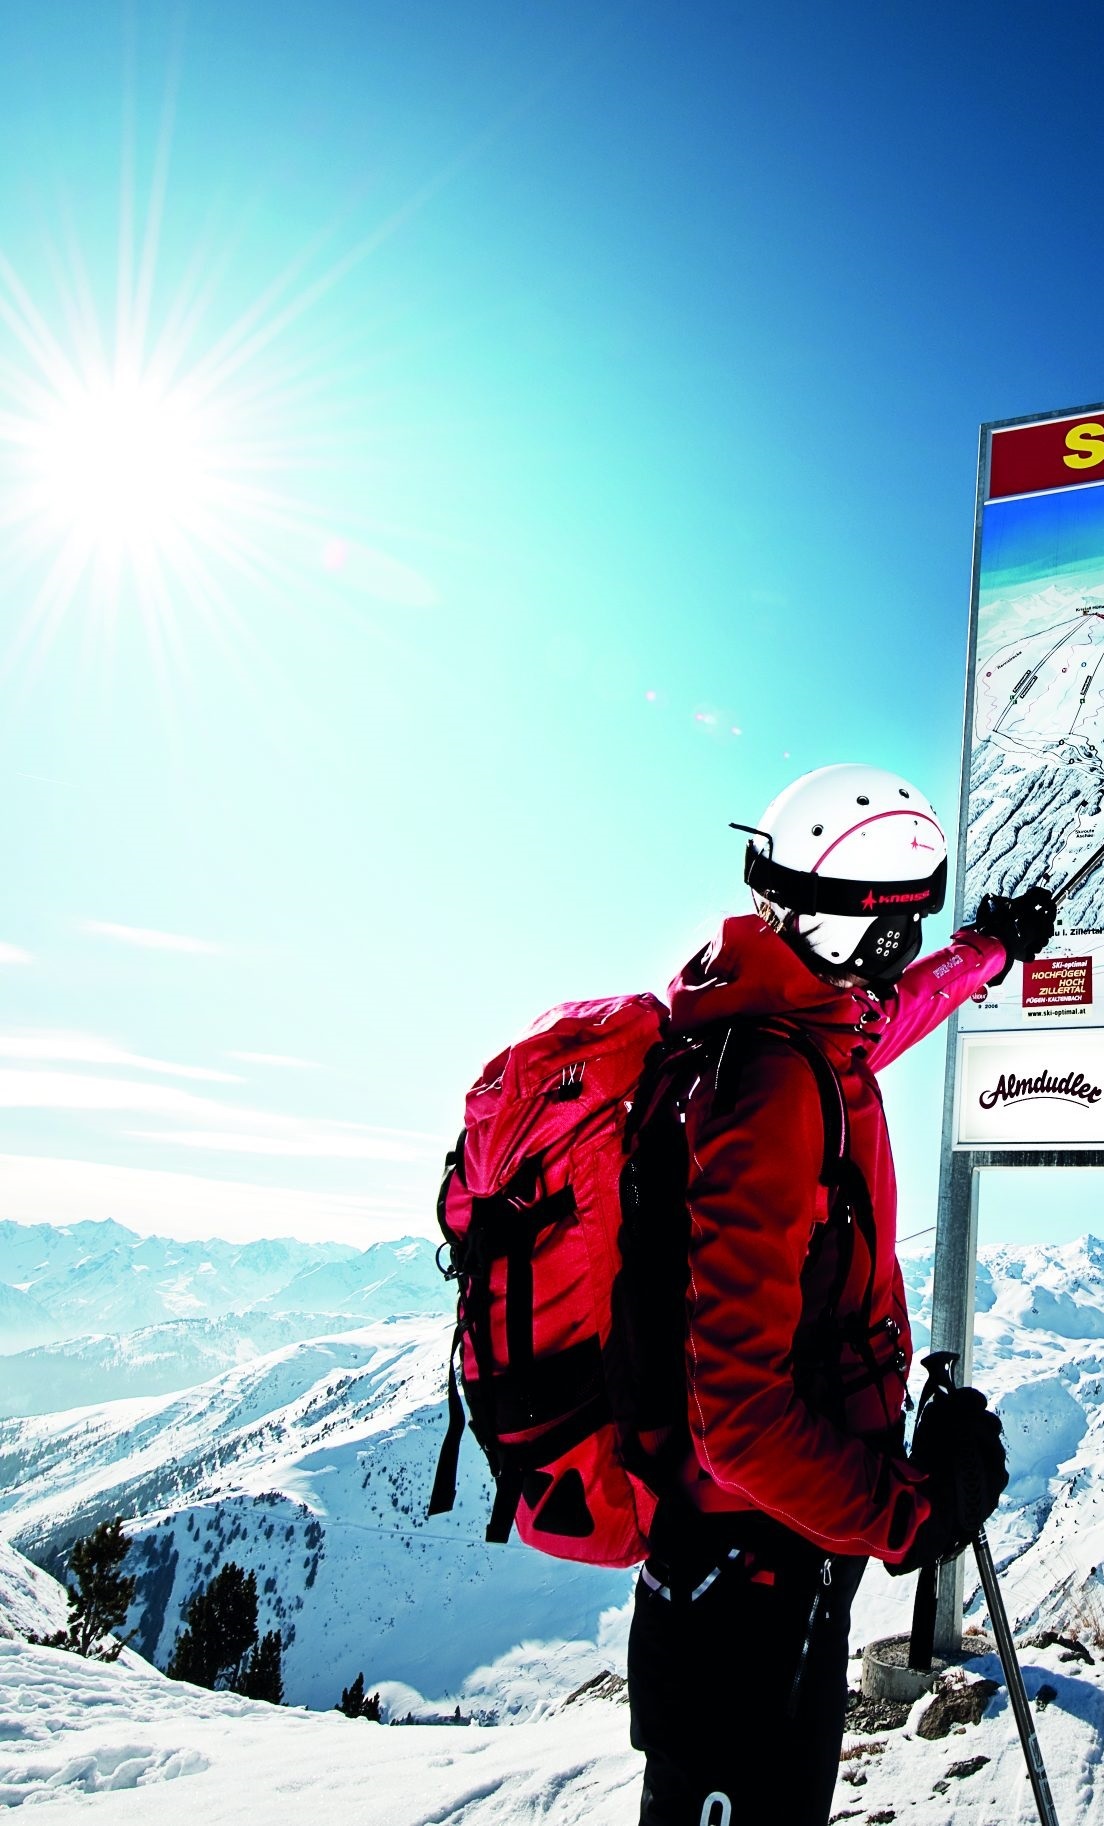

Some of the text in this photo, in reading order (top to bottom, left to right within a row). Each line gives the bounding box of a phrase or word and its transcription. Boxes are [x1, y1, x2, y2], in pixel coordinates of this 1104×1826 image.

[1031, 969, 1087, 980] HOCHFÜGEN
[1059, 978, 1085, 987] HOCH
[1039, 986, 1086, 996] ZILLERTAL
[1028, 1008, 1086, 1017] www.ski-optimal.at
[979, 1069, 1102, 1110] Almdudler
